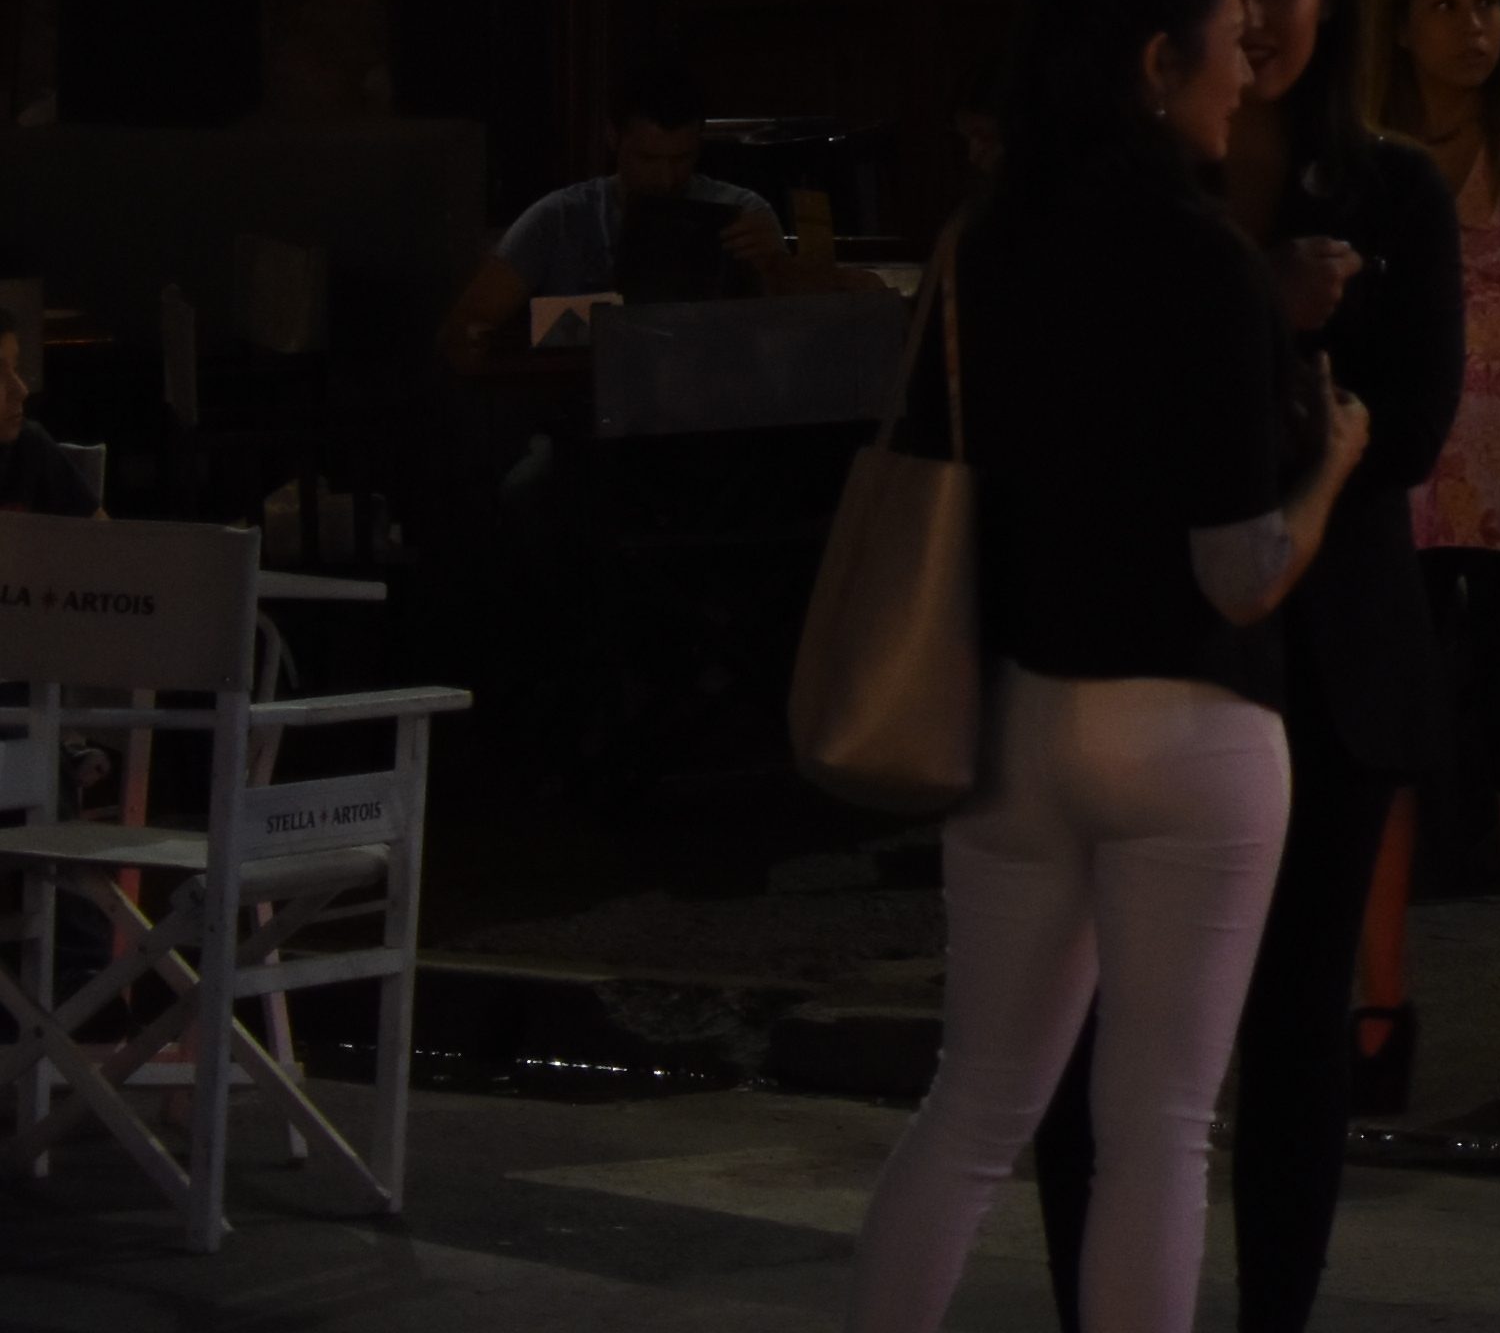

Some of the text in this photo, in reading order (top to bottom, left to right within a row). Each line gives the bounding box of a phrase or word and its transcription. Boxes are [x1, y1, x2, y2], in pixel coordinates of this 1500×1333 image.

[63, 590, 155, 615] ARTOIS
[266, 801, 382, 834] STELLA ARTOIS
